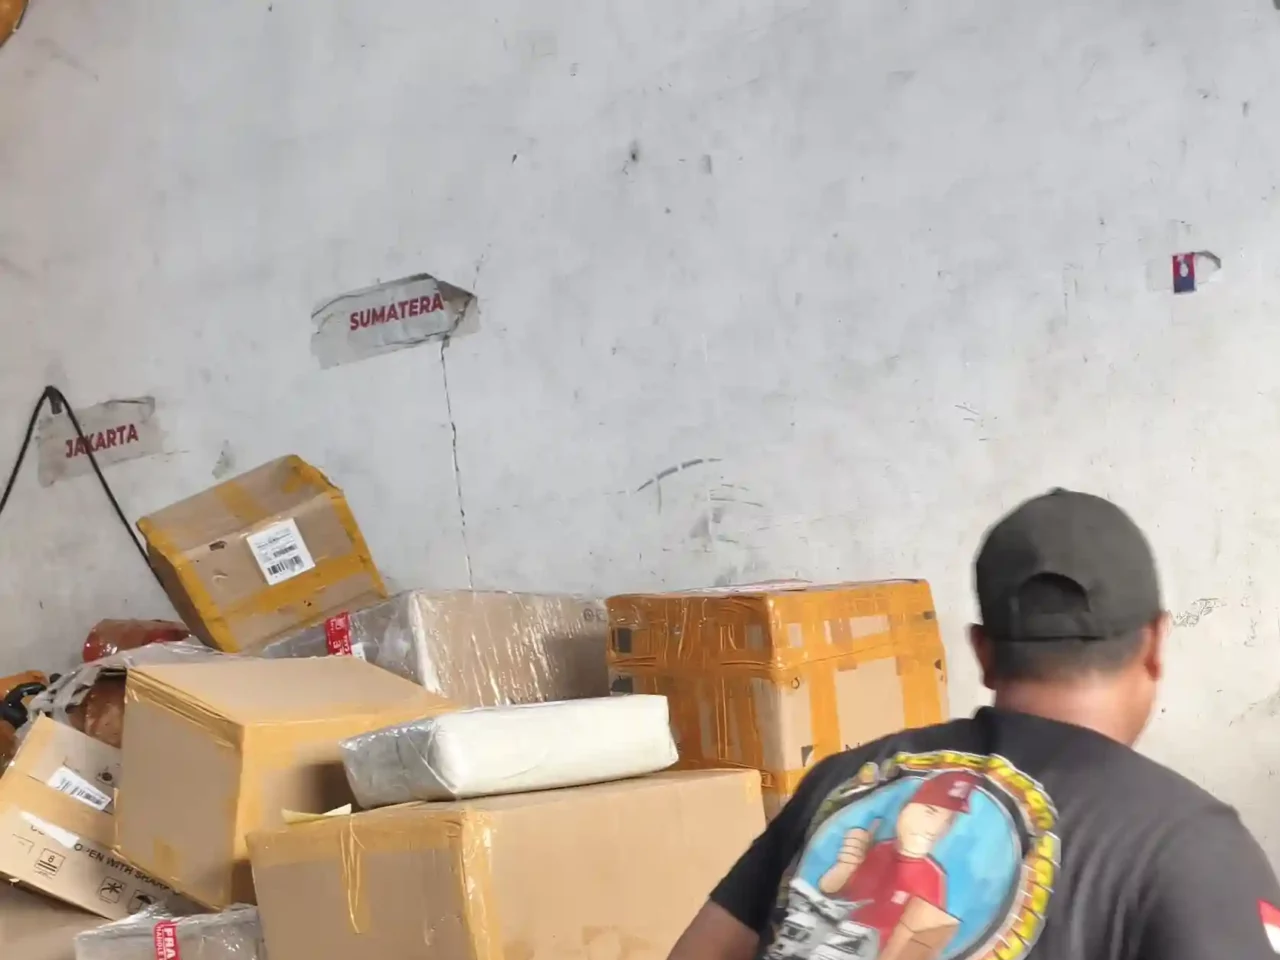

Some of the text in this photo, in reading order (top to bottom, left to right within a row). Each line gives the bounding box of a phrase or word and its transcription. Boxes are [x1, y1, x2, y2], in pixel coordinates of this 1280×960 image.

[350, 292, 444, 331] SUMATERA
[65, 423, 139, 458] JAKARTA
[106, 858, 134, 875] WITH
